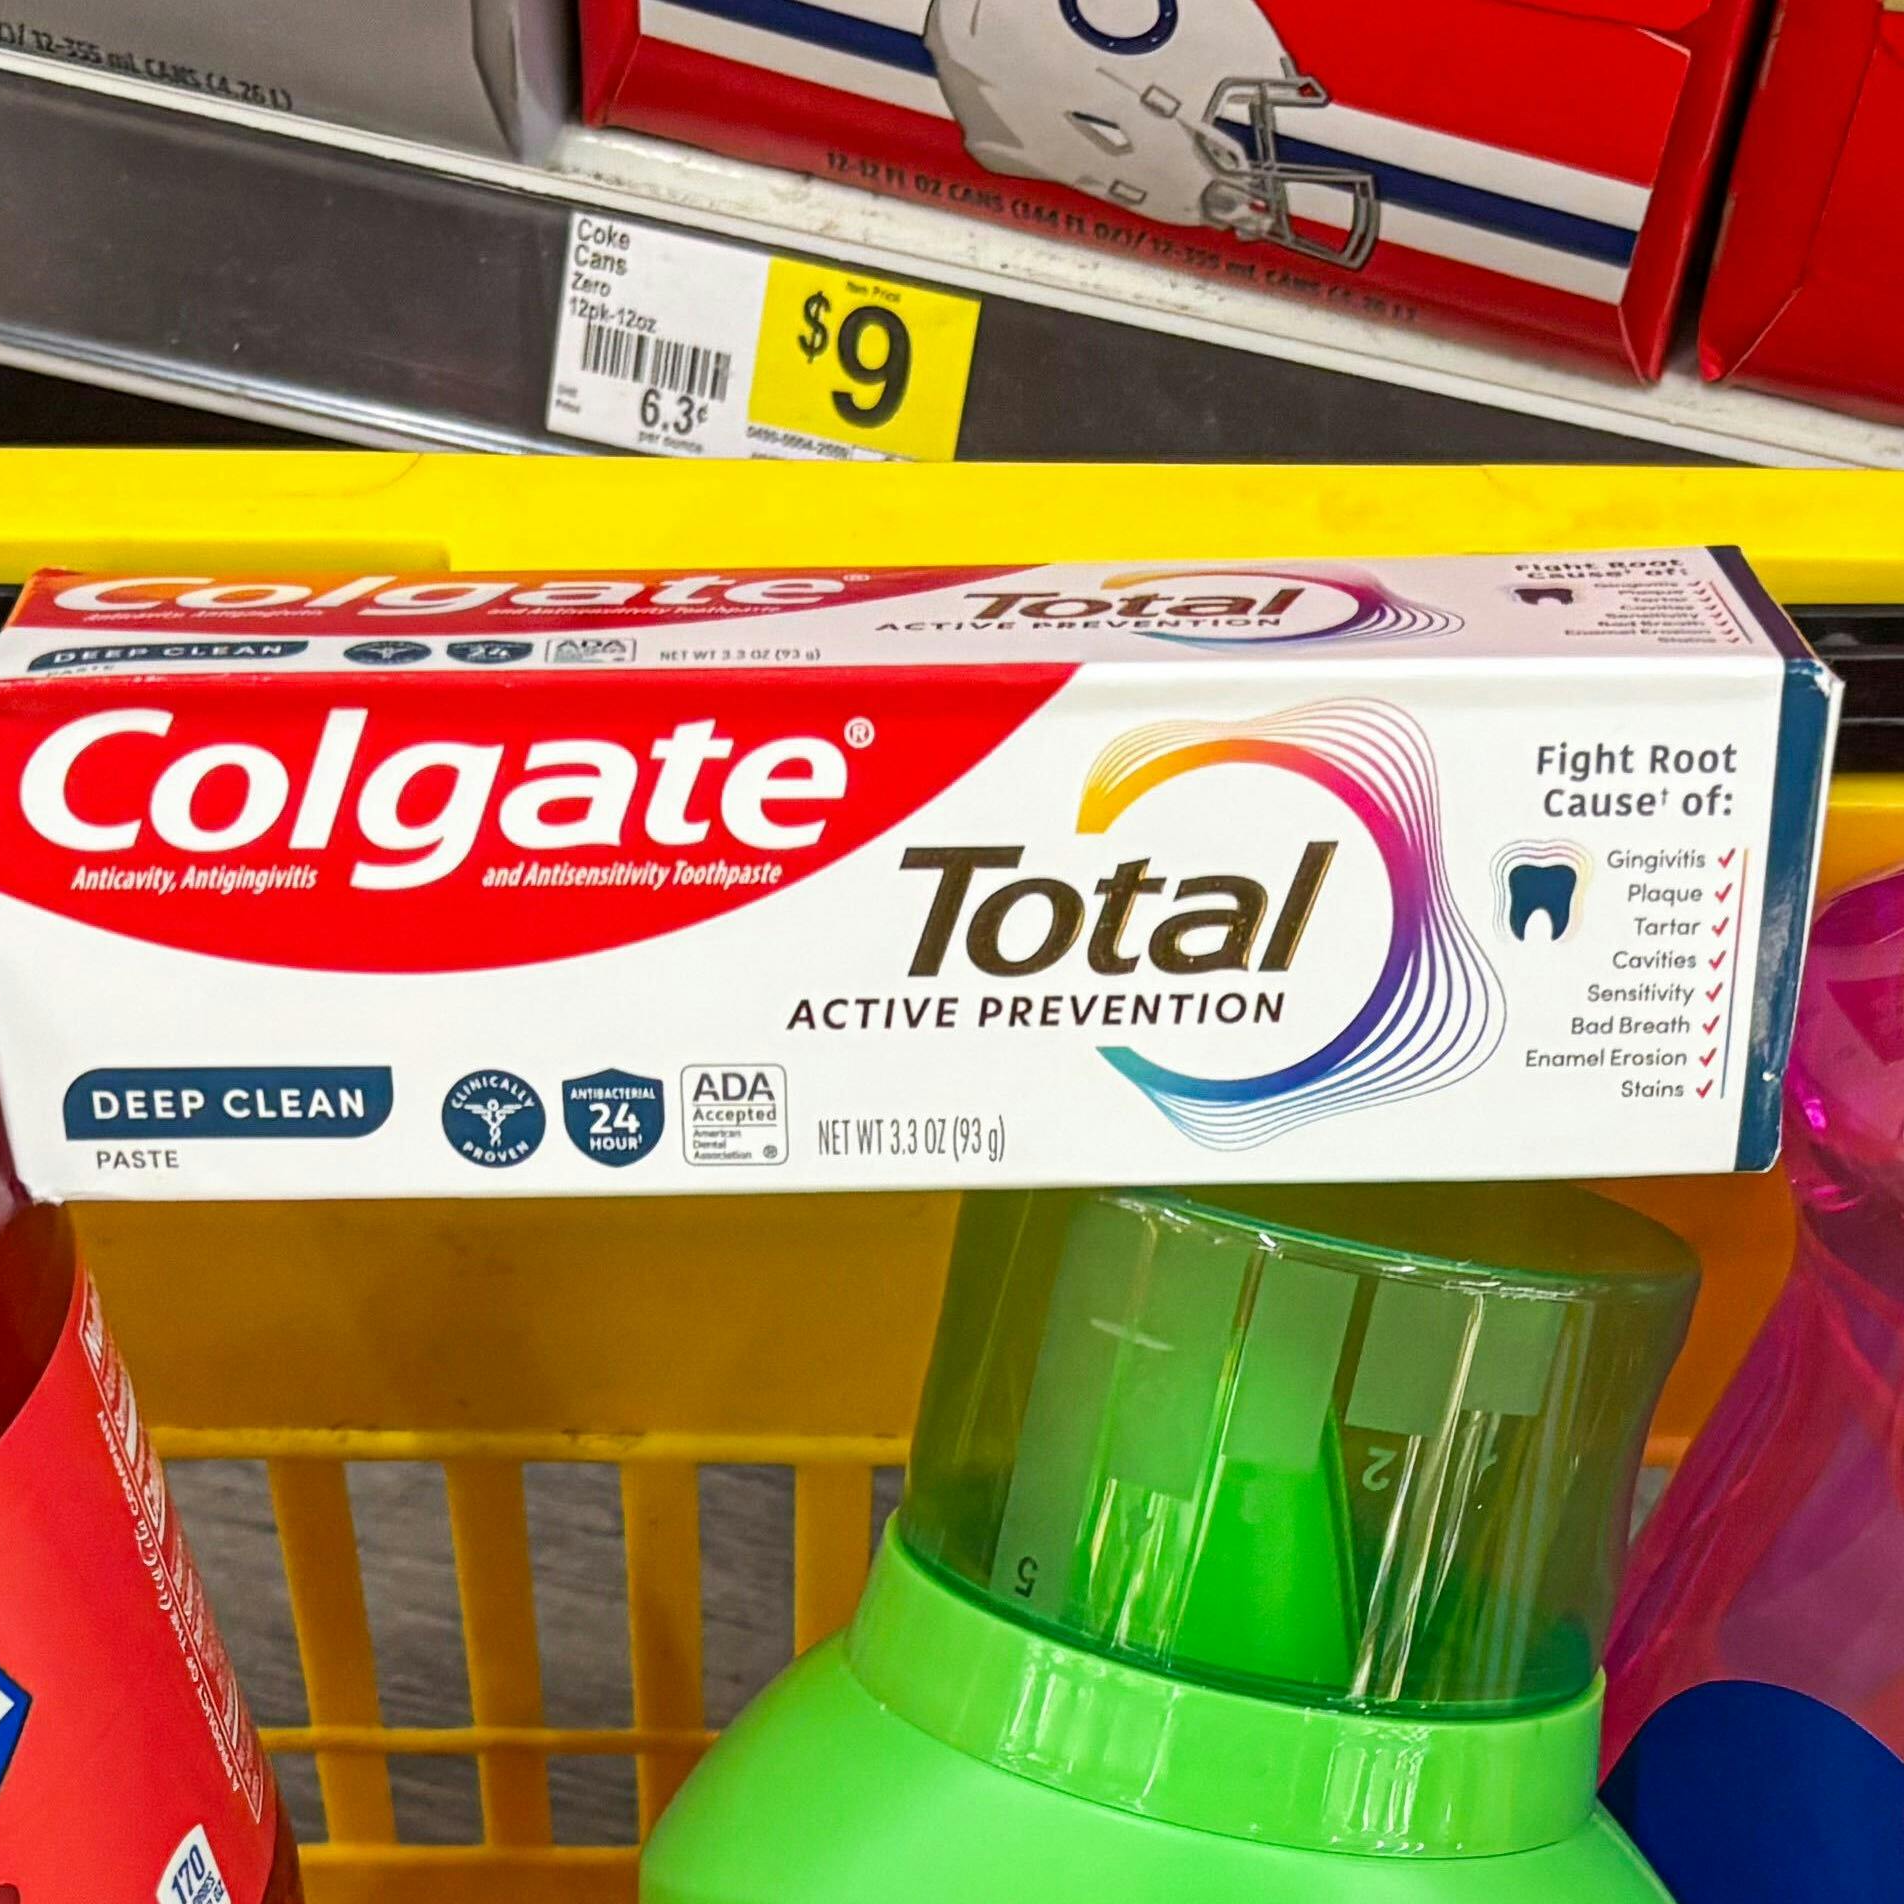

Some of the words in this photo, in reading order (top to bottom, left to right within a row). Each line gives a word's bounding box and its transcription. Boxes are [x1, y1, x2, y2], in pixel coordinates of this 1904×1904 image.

[577, 217, 631, 251] Coke
[573, 243, 628, 276] Cans
[571, 270, 612, 298] Zero
[568, 296, 658, 335] 12pk-12oz
[796, 289, 913, 430] $9
[963, 587, 1307, 620] Total
[875, 618, 1018, 633] ACTIVE
[1031, 618, 1281, 630] PREVENTION
[53, 646, 148, 665] DEEP
[162, 643, 284, 658] CLEAN
[1536, 741, 1635, 782] Fight
[1649, 742, 1738, 776] Root
[1681, 783, 1736, 817] of:
[482, 862, 520, 888] and
[522, 861, 671, 891] Antisensitivity
[671, 860, 783, 890] Toothpaste
[1606, 849, 1707, 873] Gingivitis
[70, 863, 177, 894] Anticavity,
[179, 862, 319, 894] Antigingivitis
[899, 839, 1339, 979] Total
[1626, 882, 1704, 908] Plaque
[1633, 917, 1702, 937] Tartar
[1612, 949, 1698, 971] Cavities
[787, 996, 959, 1031] ACTIVE
[979, 990, 1286, 1029] PREVENTION
[1586, 982, 1696, 1011] Sensitivity
[1570, 1015, 1616, 1036] Bad
[1618, 1014, 1692, 1035] Breath
[1524, 1048, 1607, 1069] Enamel
[1609, 1046, 1688, 1067] Erosion
[449, 1074, 537, 1110] CLINICALLY
[569, 1085, 657, 1101] ANTIBACTERIAL
[692, 1070, 777, 1103] ADA
[1620, 1079, 1686, 1099] Stains
[91, 1089, 206, 1122] DEEP
[221, 1087, 366, 1120] CLEAN
[587, 1100, 641, 1136] 24
[692, 1105, 778, 1127] Accepted
[461, 1139, 531, 1165] PROVEN
[817, 1117, 852, 1157] NET
[853, 1117, 885, 1156] WT
[887, 1116, 919, 1156] 3.3
[922, 1116, 948, 1156] OZ
[951, 1115, 984, 1162] (93
[986, 1118, 1009, 1163] g)
[96, 1149, 181, 1171] PASTE
